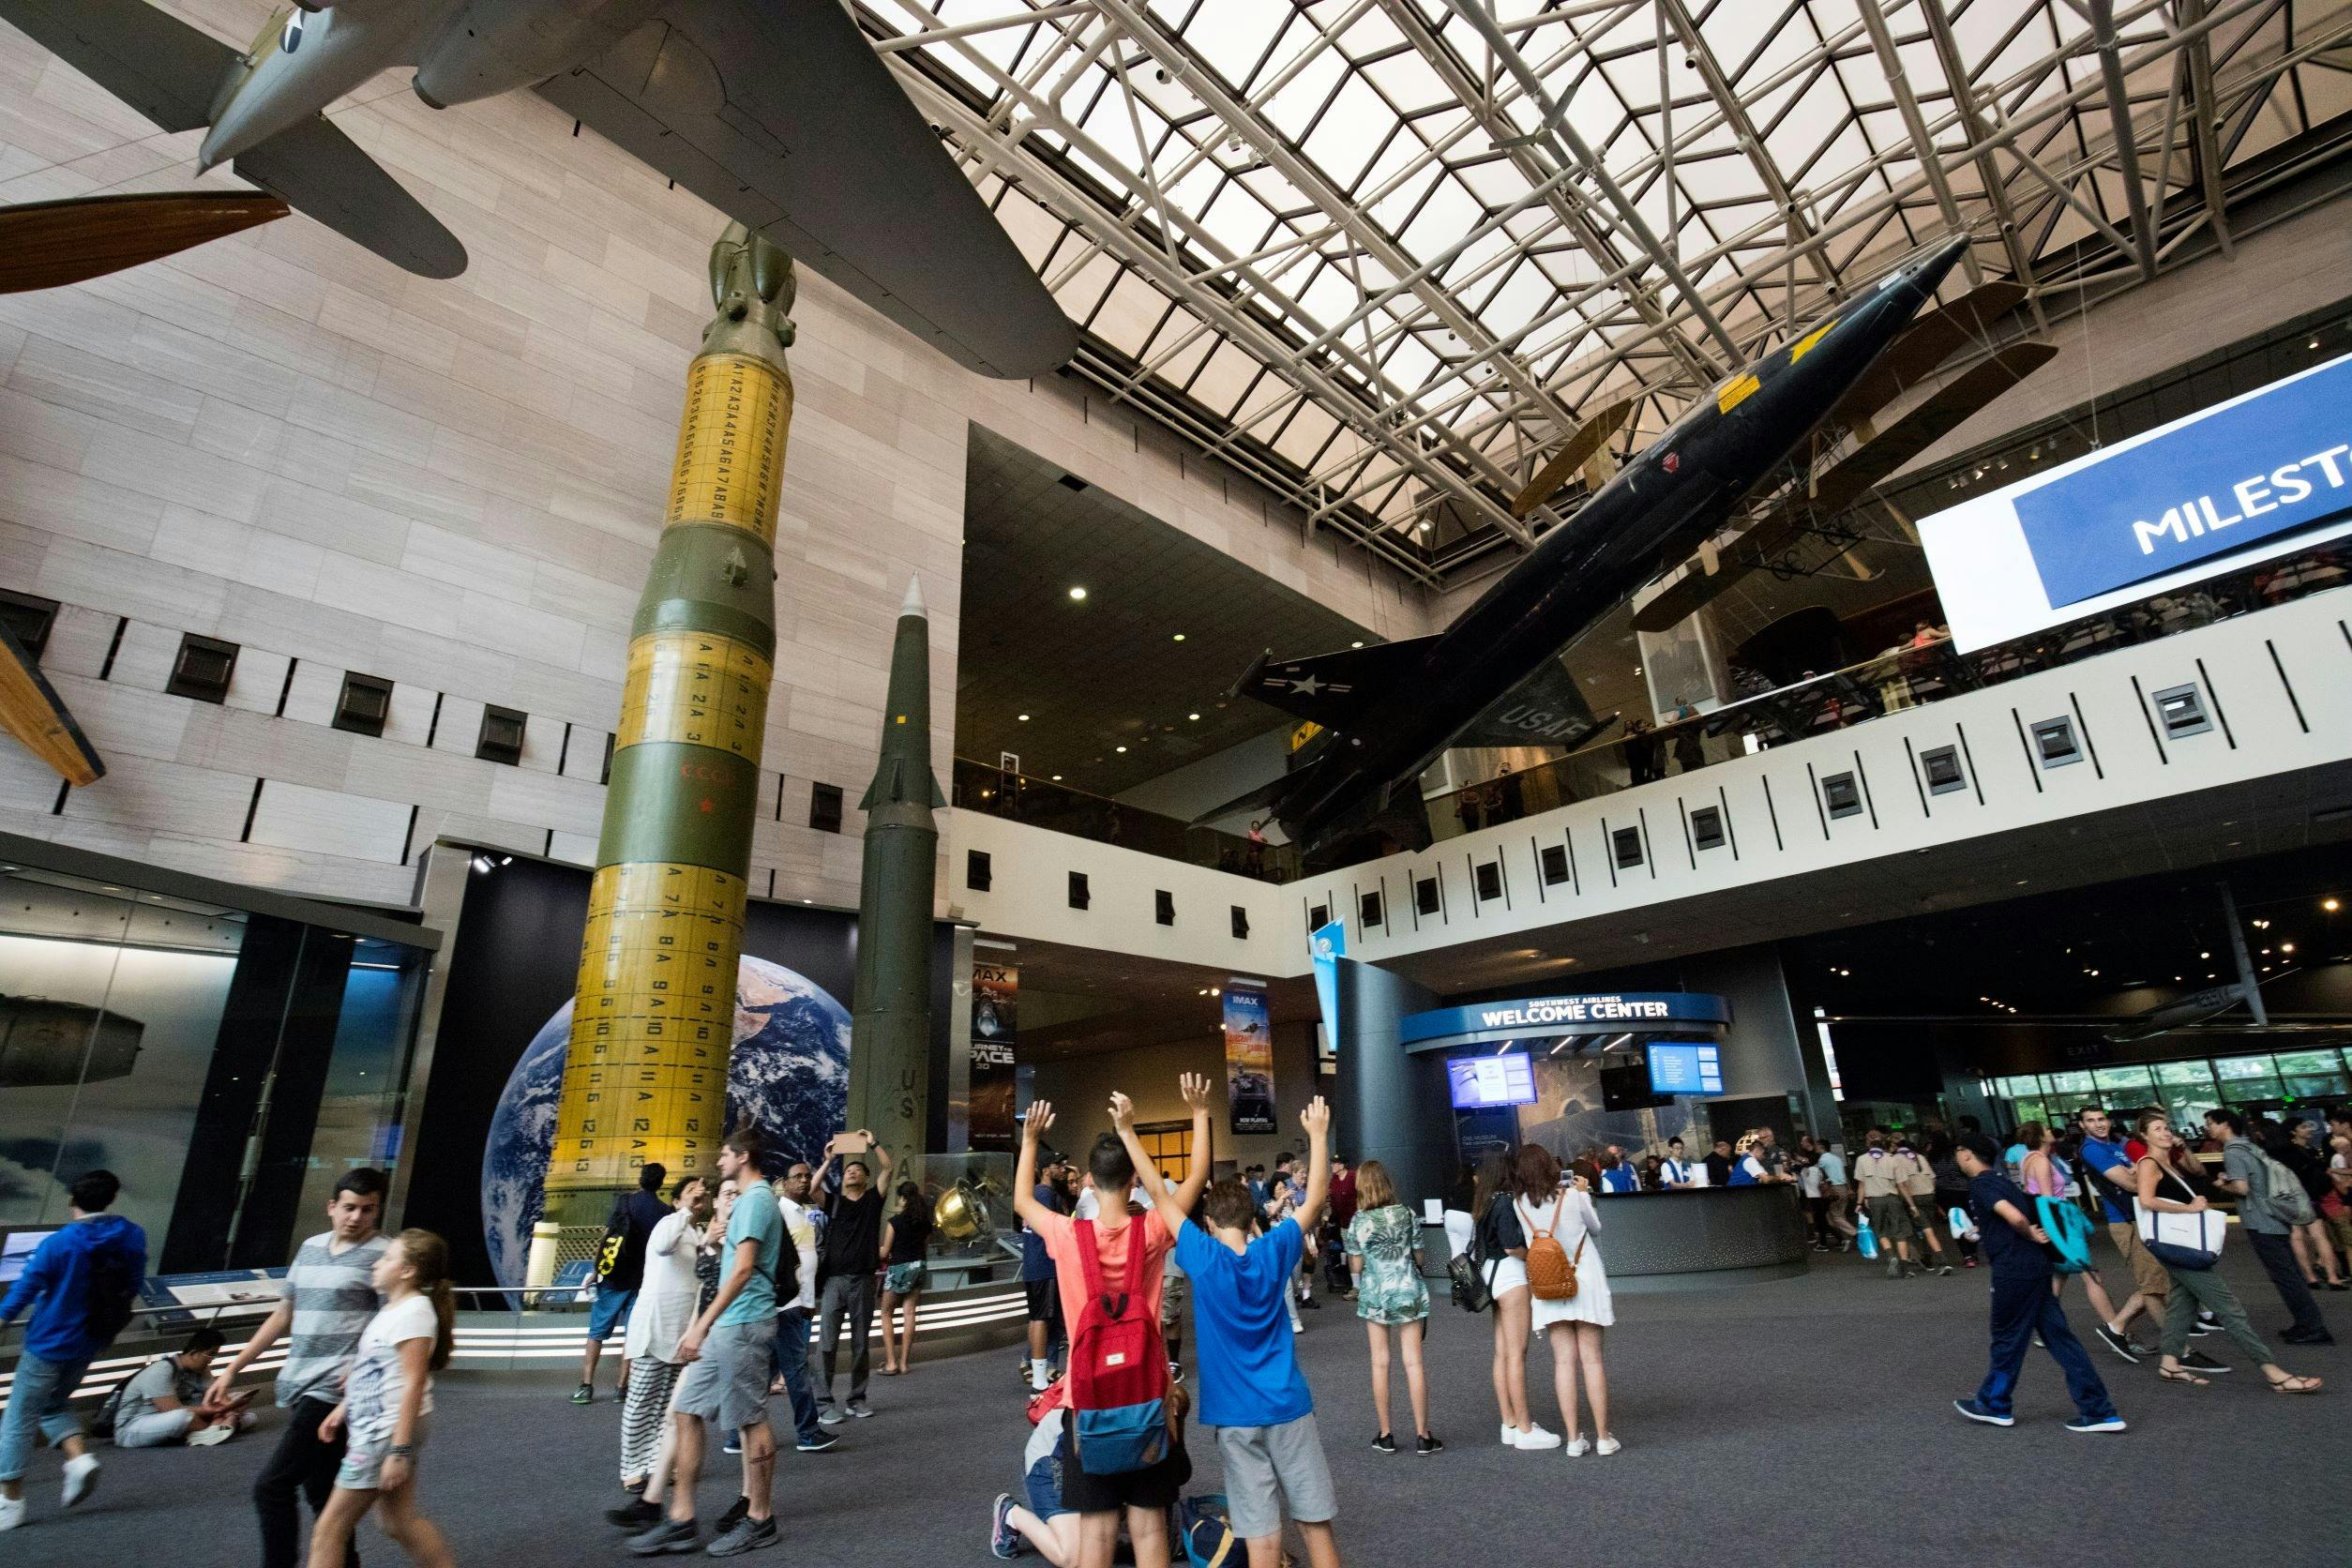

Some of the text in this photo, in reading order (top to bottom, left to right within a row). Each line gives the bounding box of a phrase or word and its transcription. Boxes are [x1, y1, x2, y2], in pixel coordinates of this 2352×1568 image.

[2132, 444, 2352, 555] MILEST
[1500, 704, 1591, 738] USAF
[1232, 995, 1259, 1006] IMAX
[1529, 996, 1621, 1008] SOUTHWEST AIRLINES
[1482, 1003, 1668, 1027] WELCOME CENTER
